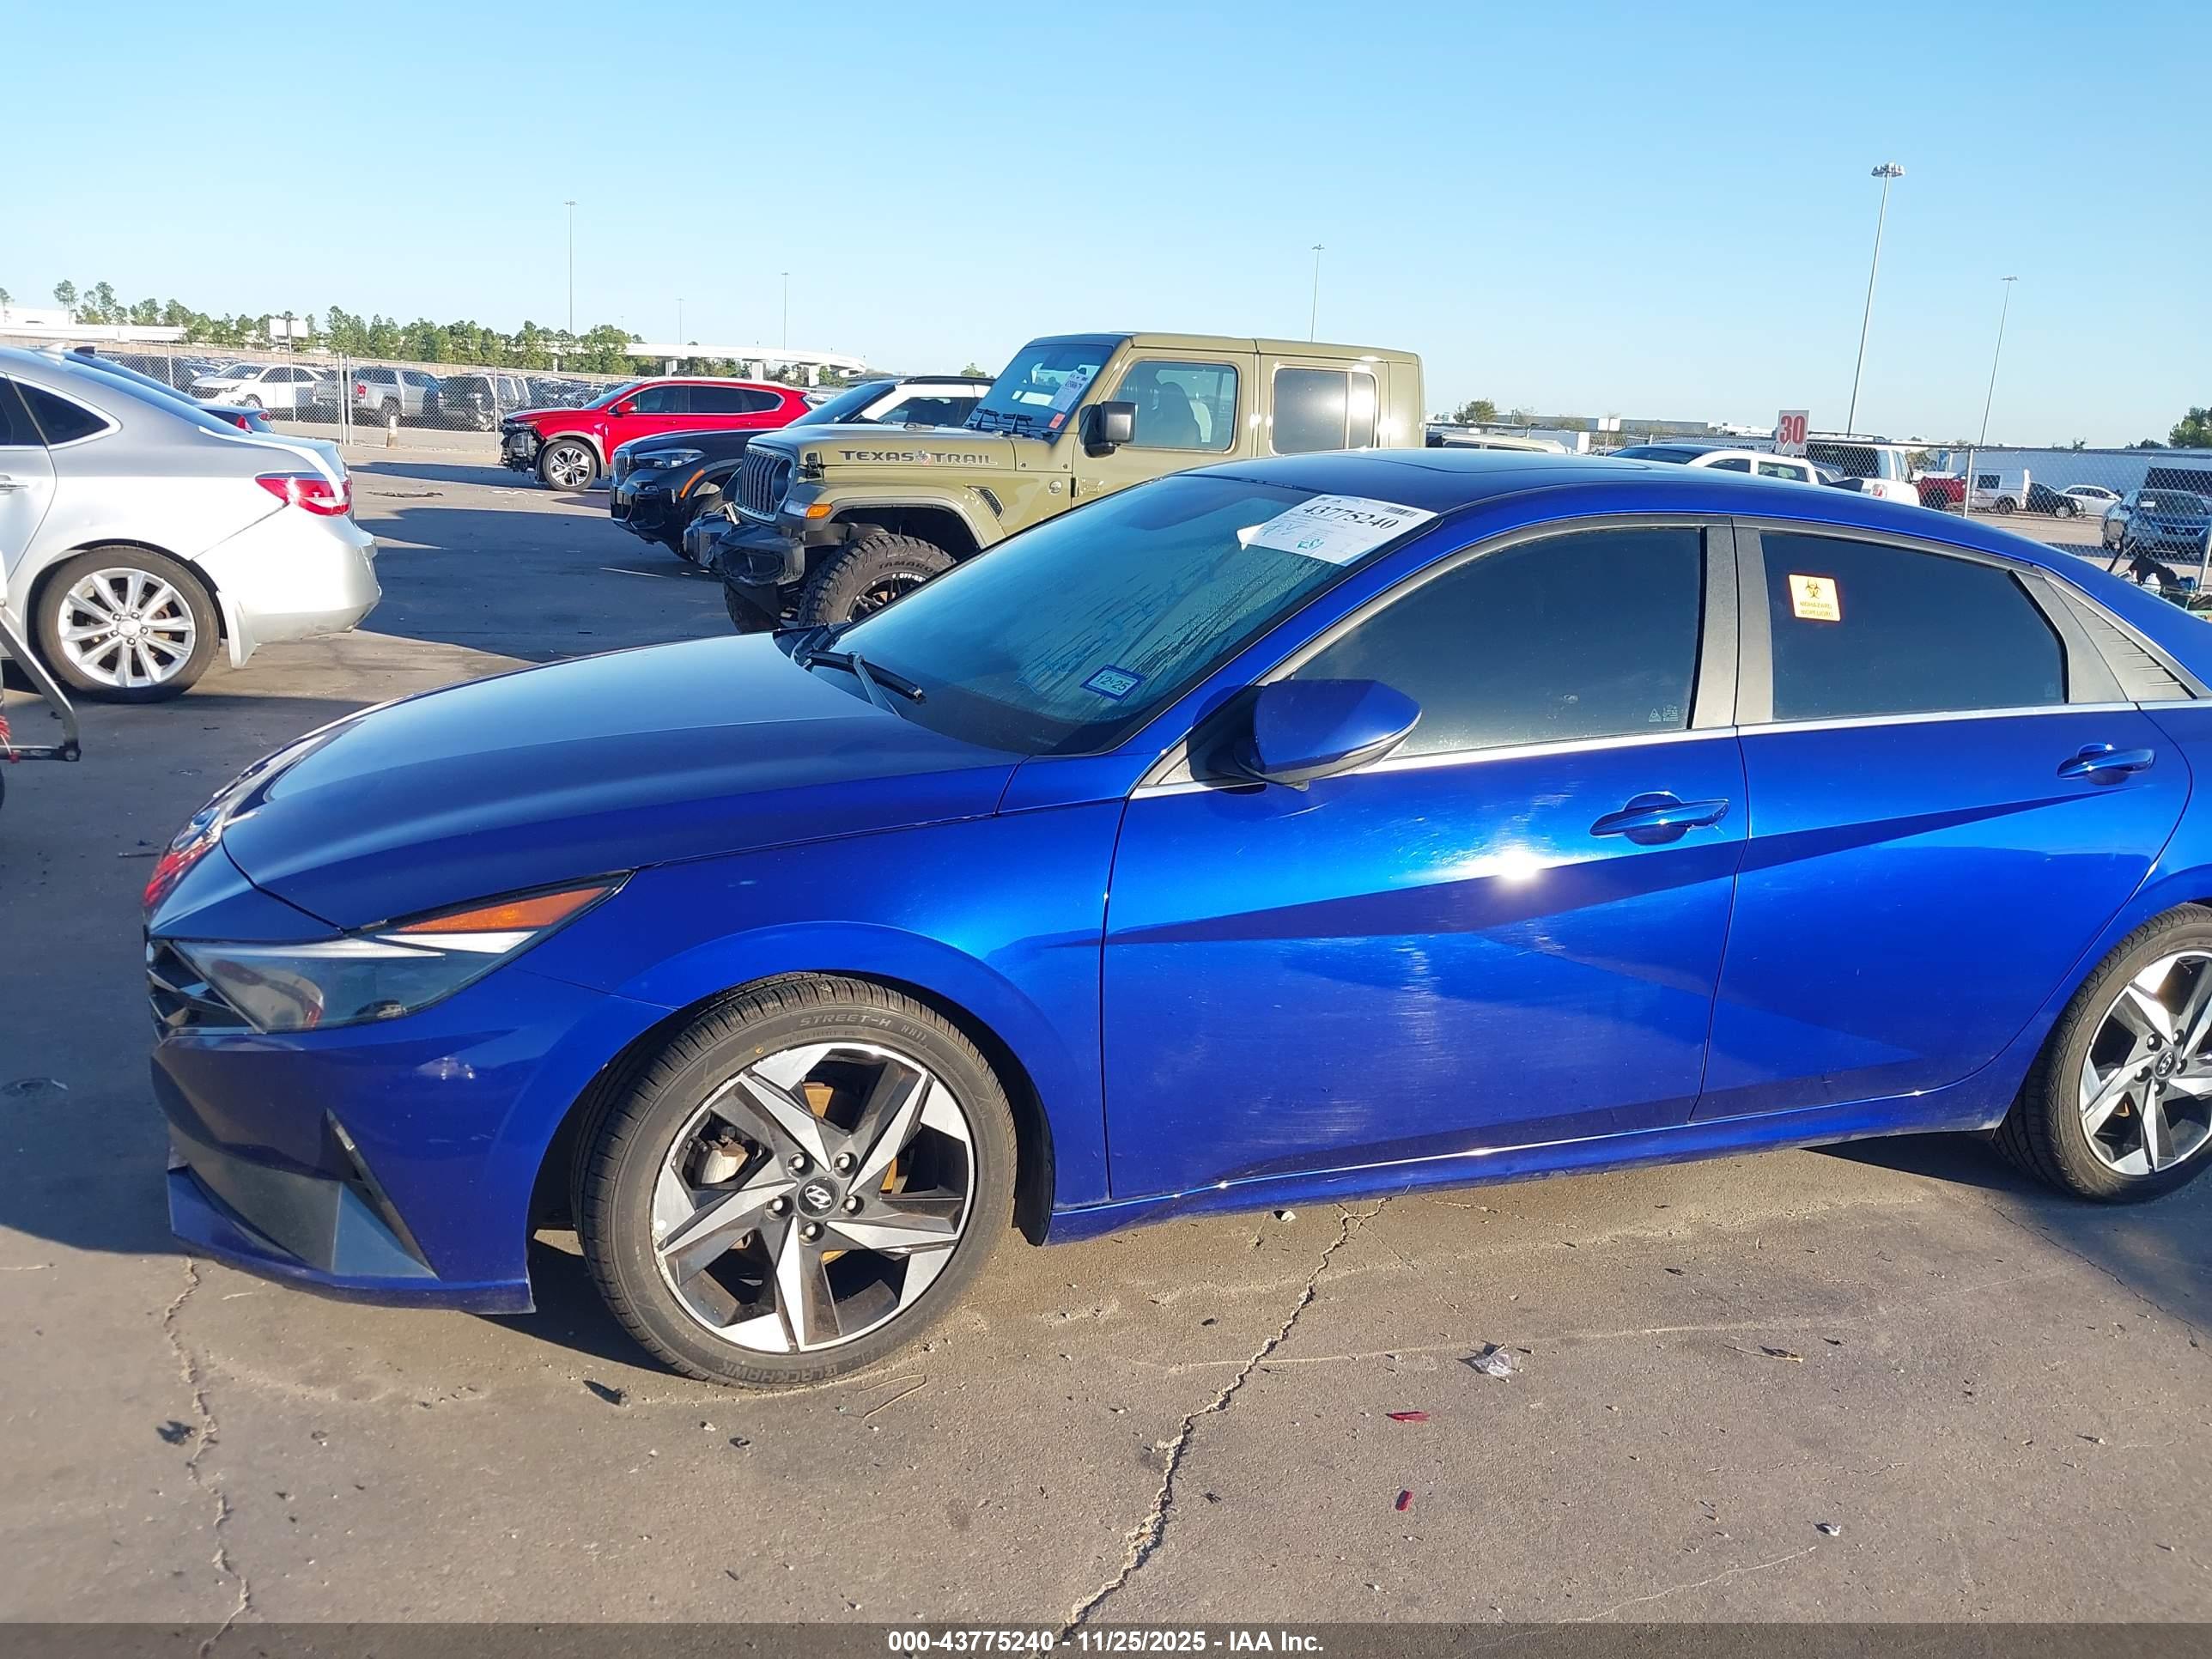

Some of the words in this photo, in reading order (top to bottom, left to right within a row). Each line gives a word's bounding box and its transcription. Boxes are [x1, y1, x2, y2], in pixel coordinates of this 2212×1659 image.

[1780, 415, 1805, 444] 30
[838, 450, 915, 462] TEXAS
[927, 453, 998, 465] TRAIL
[1303, 505, 1400, 530] 43775240
[799, 1013, 893, 1028] STREET-H
